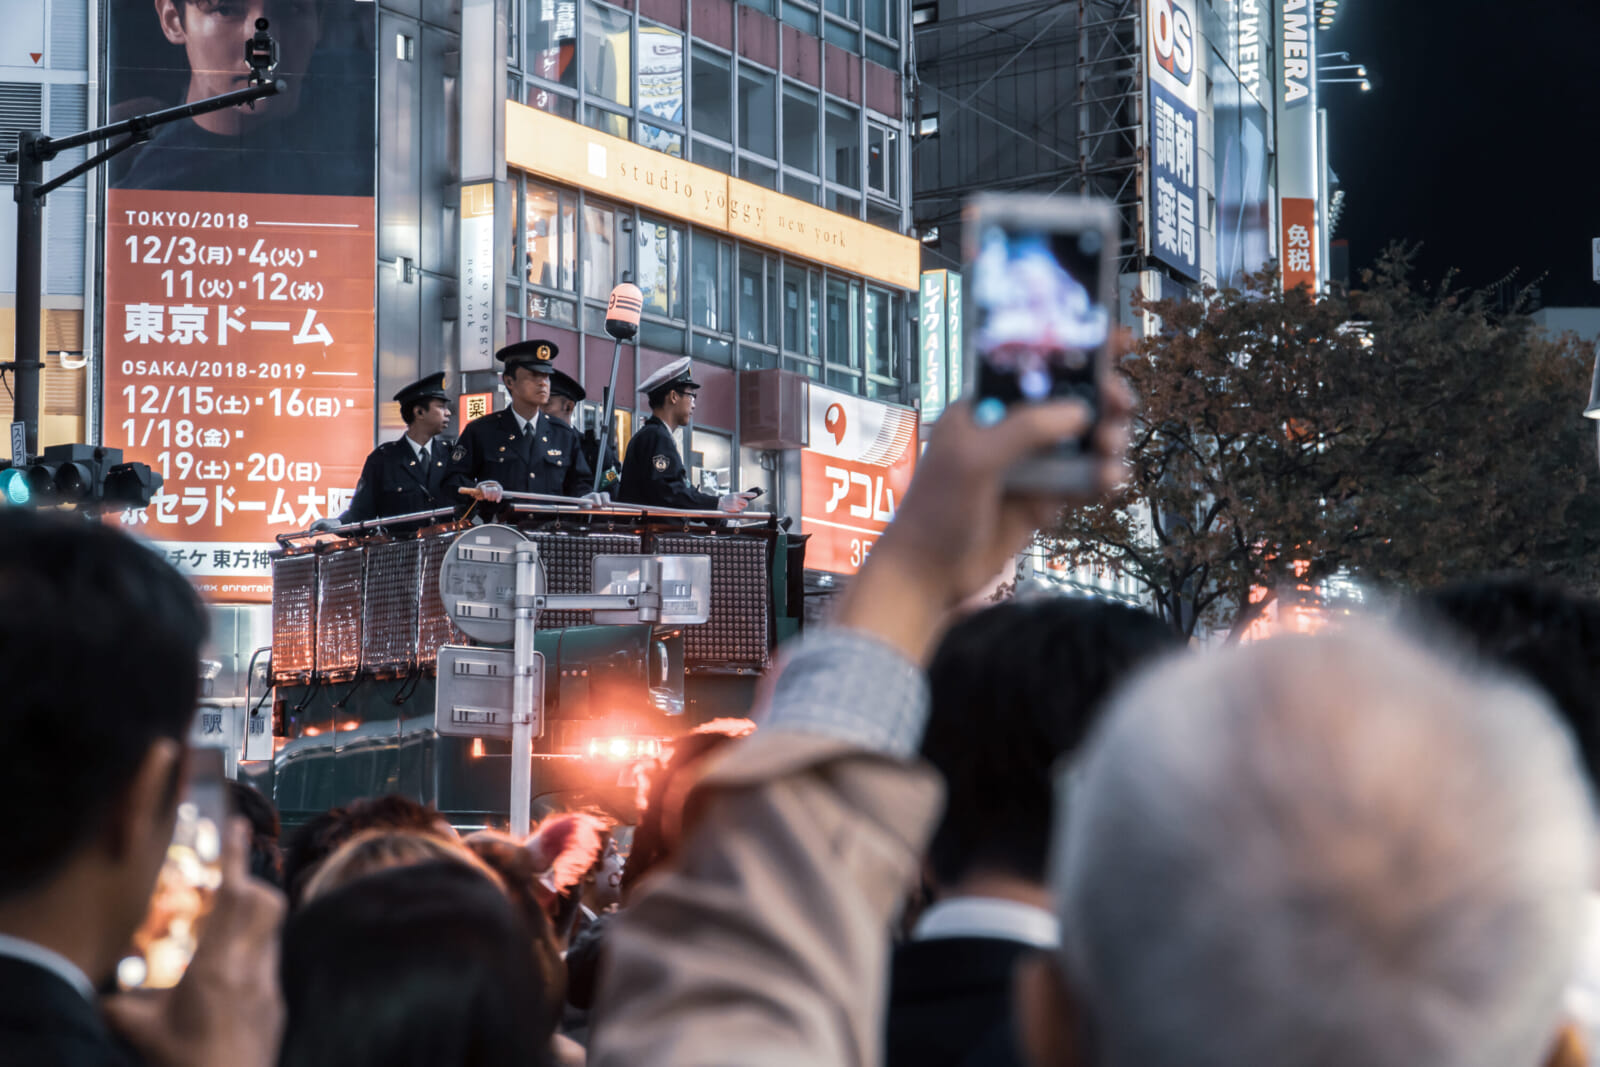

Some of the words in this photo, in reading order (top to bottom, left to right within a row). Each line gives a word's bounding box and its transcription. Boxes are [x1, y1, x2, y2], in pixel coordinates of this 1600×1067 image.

[1153, 0, 1193, 75] OS
[1156, 96, 1194, 189] 調剤
[125, 210, 249, 228] TOKYO/2018
[620, 162, 693, 199] studio
[778, 214, 806, 234] new
[814, 227, 847, 249] york
[1156, 177, 1196, 266] 薬局
[1287, 224, 1311, 272] 免税
[466, 258, 474, 286] new
[123, 302, 335, 346] 東京ドーム
[465, 295, 475, 327] york
[121, 360, 307, 379] OSAKA/2018-2019
[468, 397, 485, 418] 薬
[14, 427, 22, 466] スクラ
[825, 465, 896, 523] アコム
